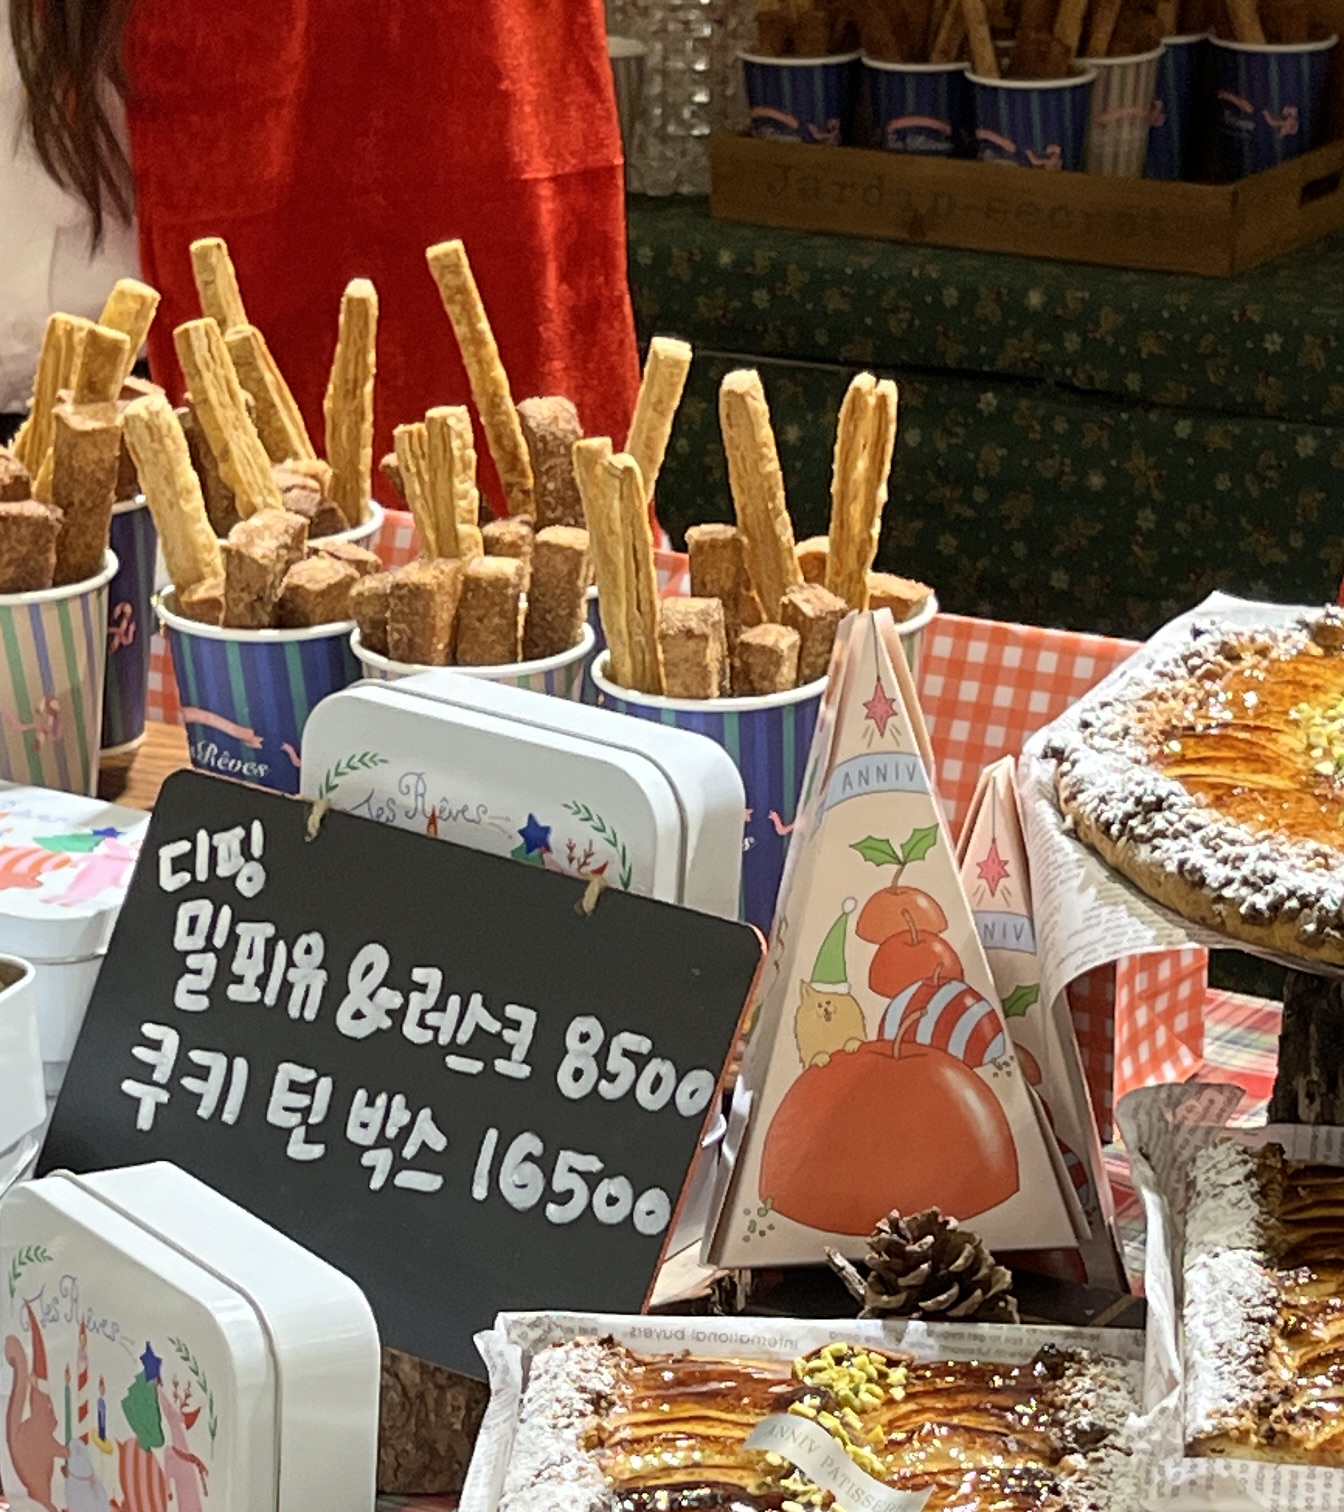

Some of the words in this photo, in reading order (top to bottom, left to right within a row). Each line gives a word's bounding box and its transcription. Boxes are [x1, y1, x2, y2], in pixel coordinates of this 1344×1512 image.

[196, 739, 270, 777] Rêves
[842, 762, 917, 796] ANNIV
[398, 772, 488, 825] Rêves
[158, 820, 265, 898] 디핑
[983, 922, 1026, 942] NIV
[555, 1016, 717, 1117] 8500
[121, 1022, 250, 1132] 쿠키
[266, 1061, 333, 1161] 틴
[346, 1088, 449, 1191] 박스
[471, 1127, 673, 1237] 16500
[769, 1421, 819, 1455] ANNIV
